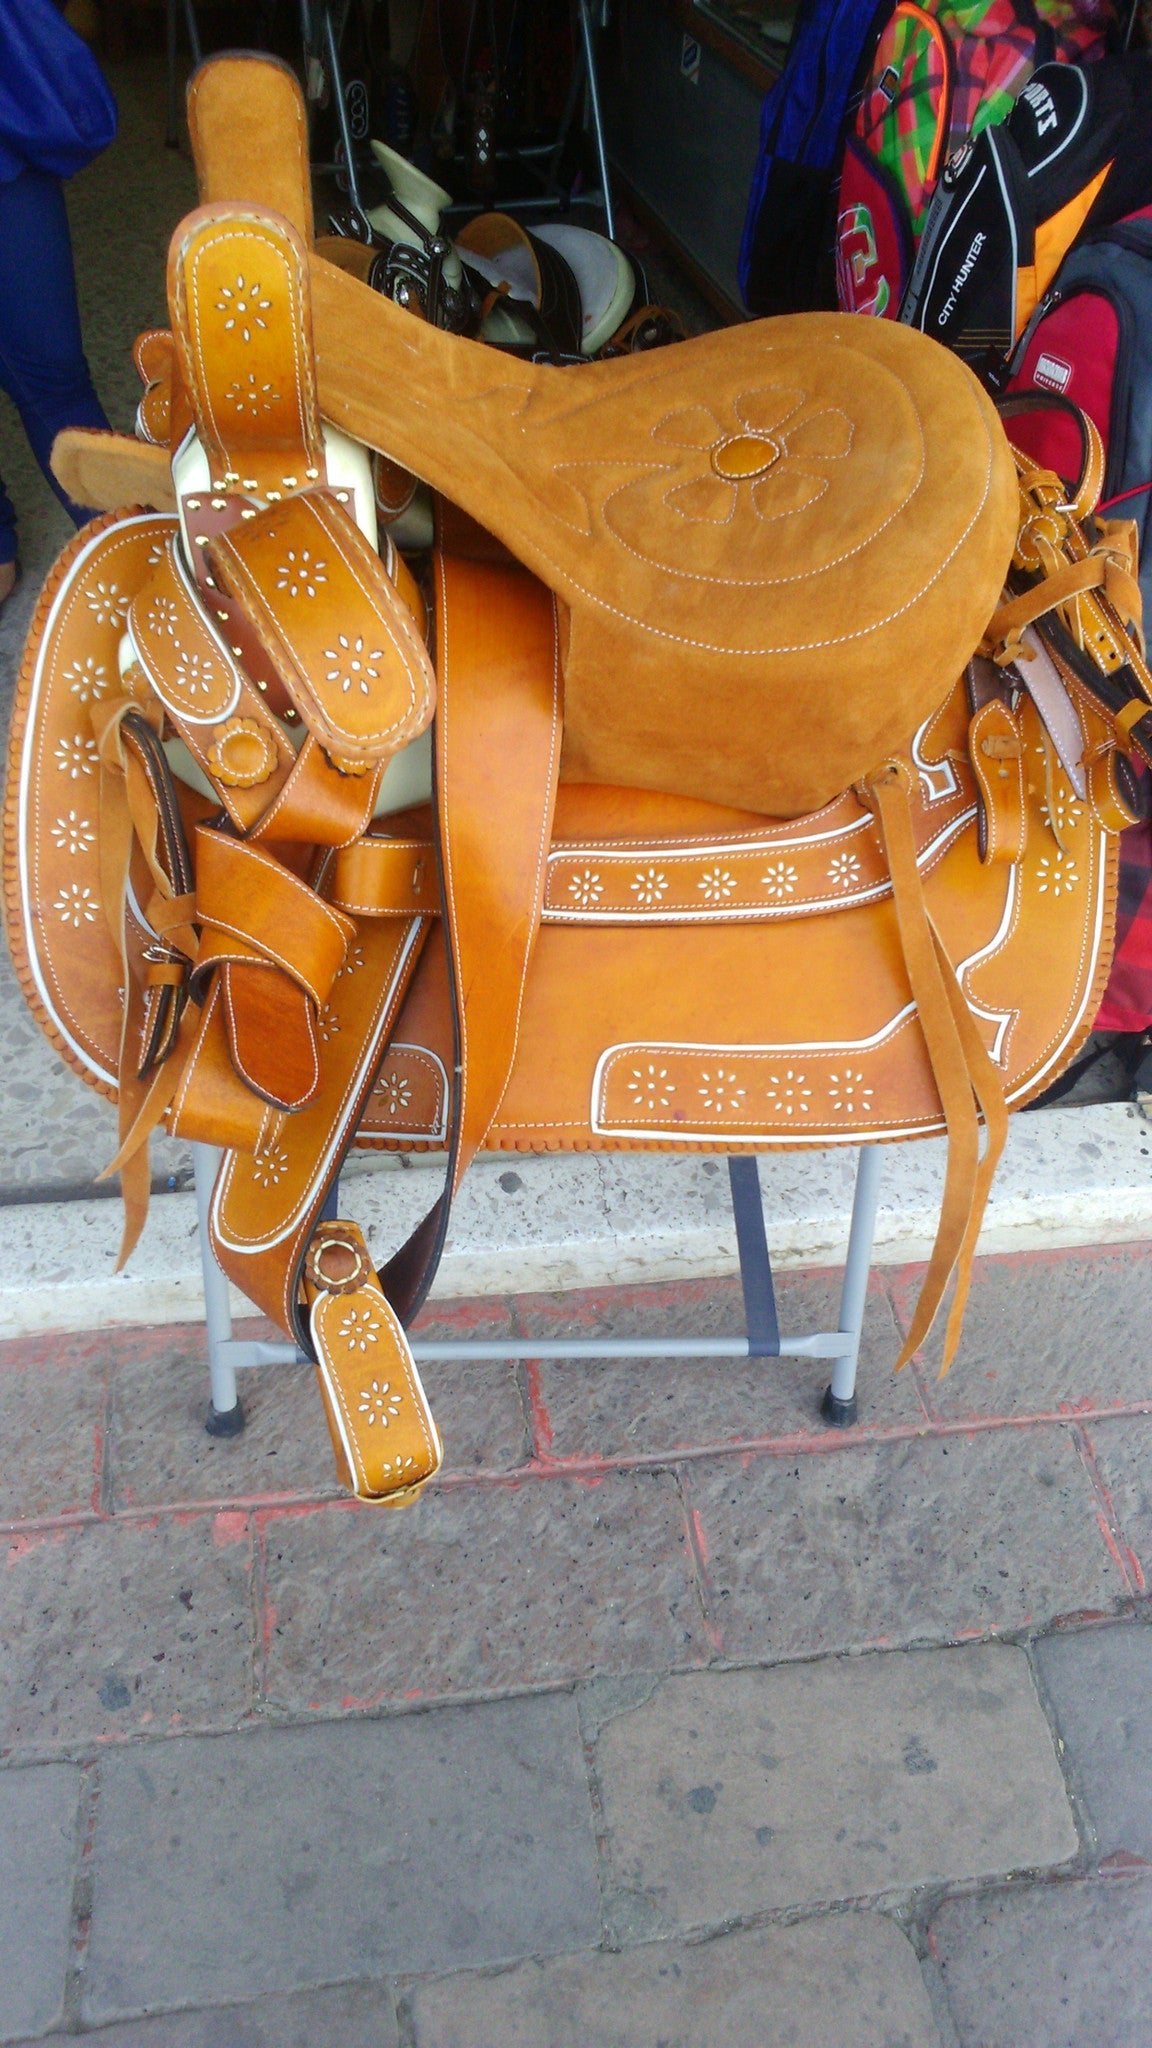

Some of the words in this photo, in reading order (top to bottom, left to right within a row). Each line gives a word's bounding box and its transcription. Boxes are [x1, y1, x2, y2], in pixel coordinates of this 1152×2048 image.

[1022, 83, 1058, 137] PORTS
[938, 291, 958, 325] CITY
[952, 231, 987, 293] HUNTER
